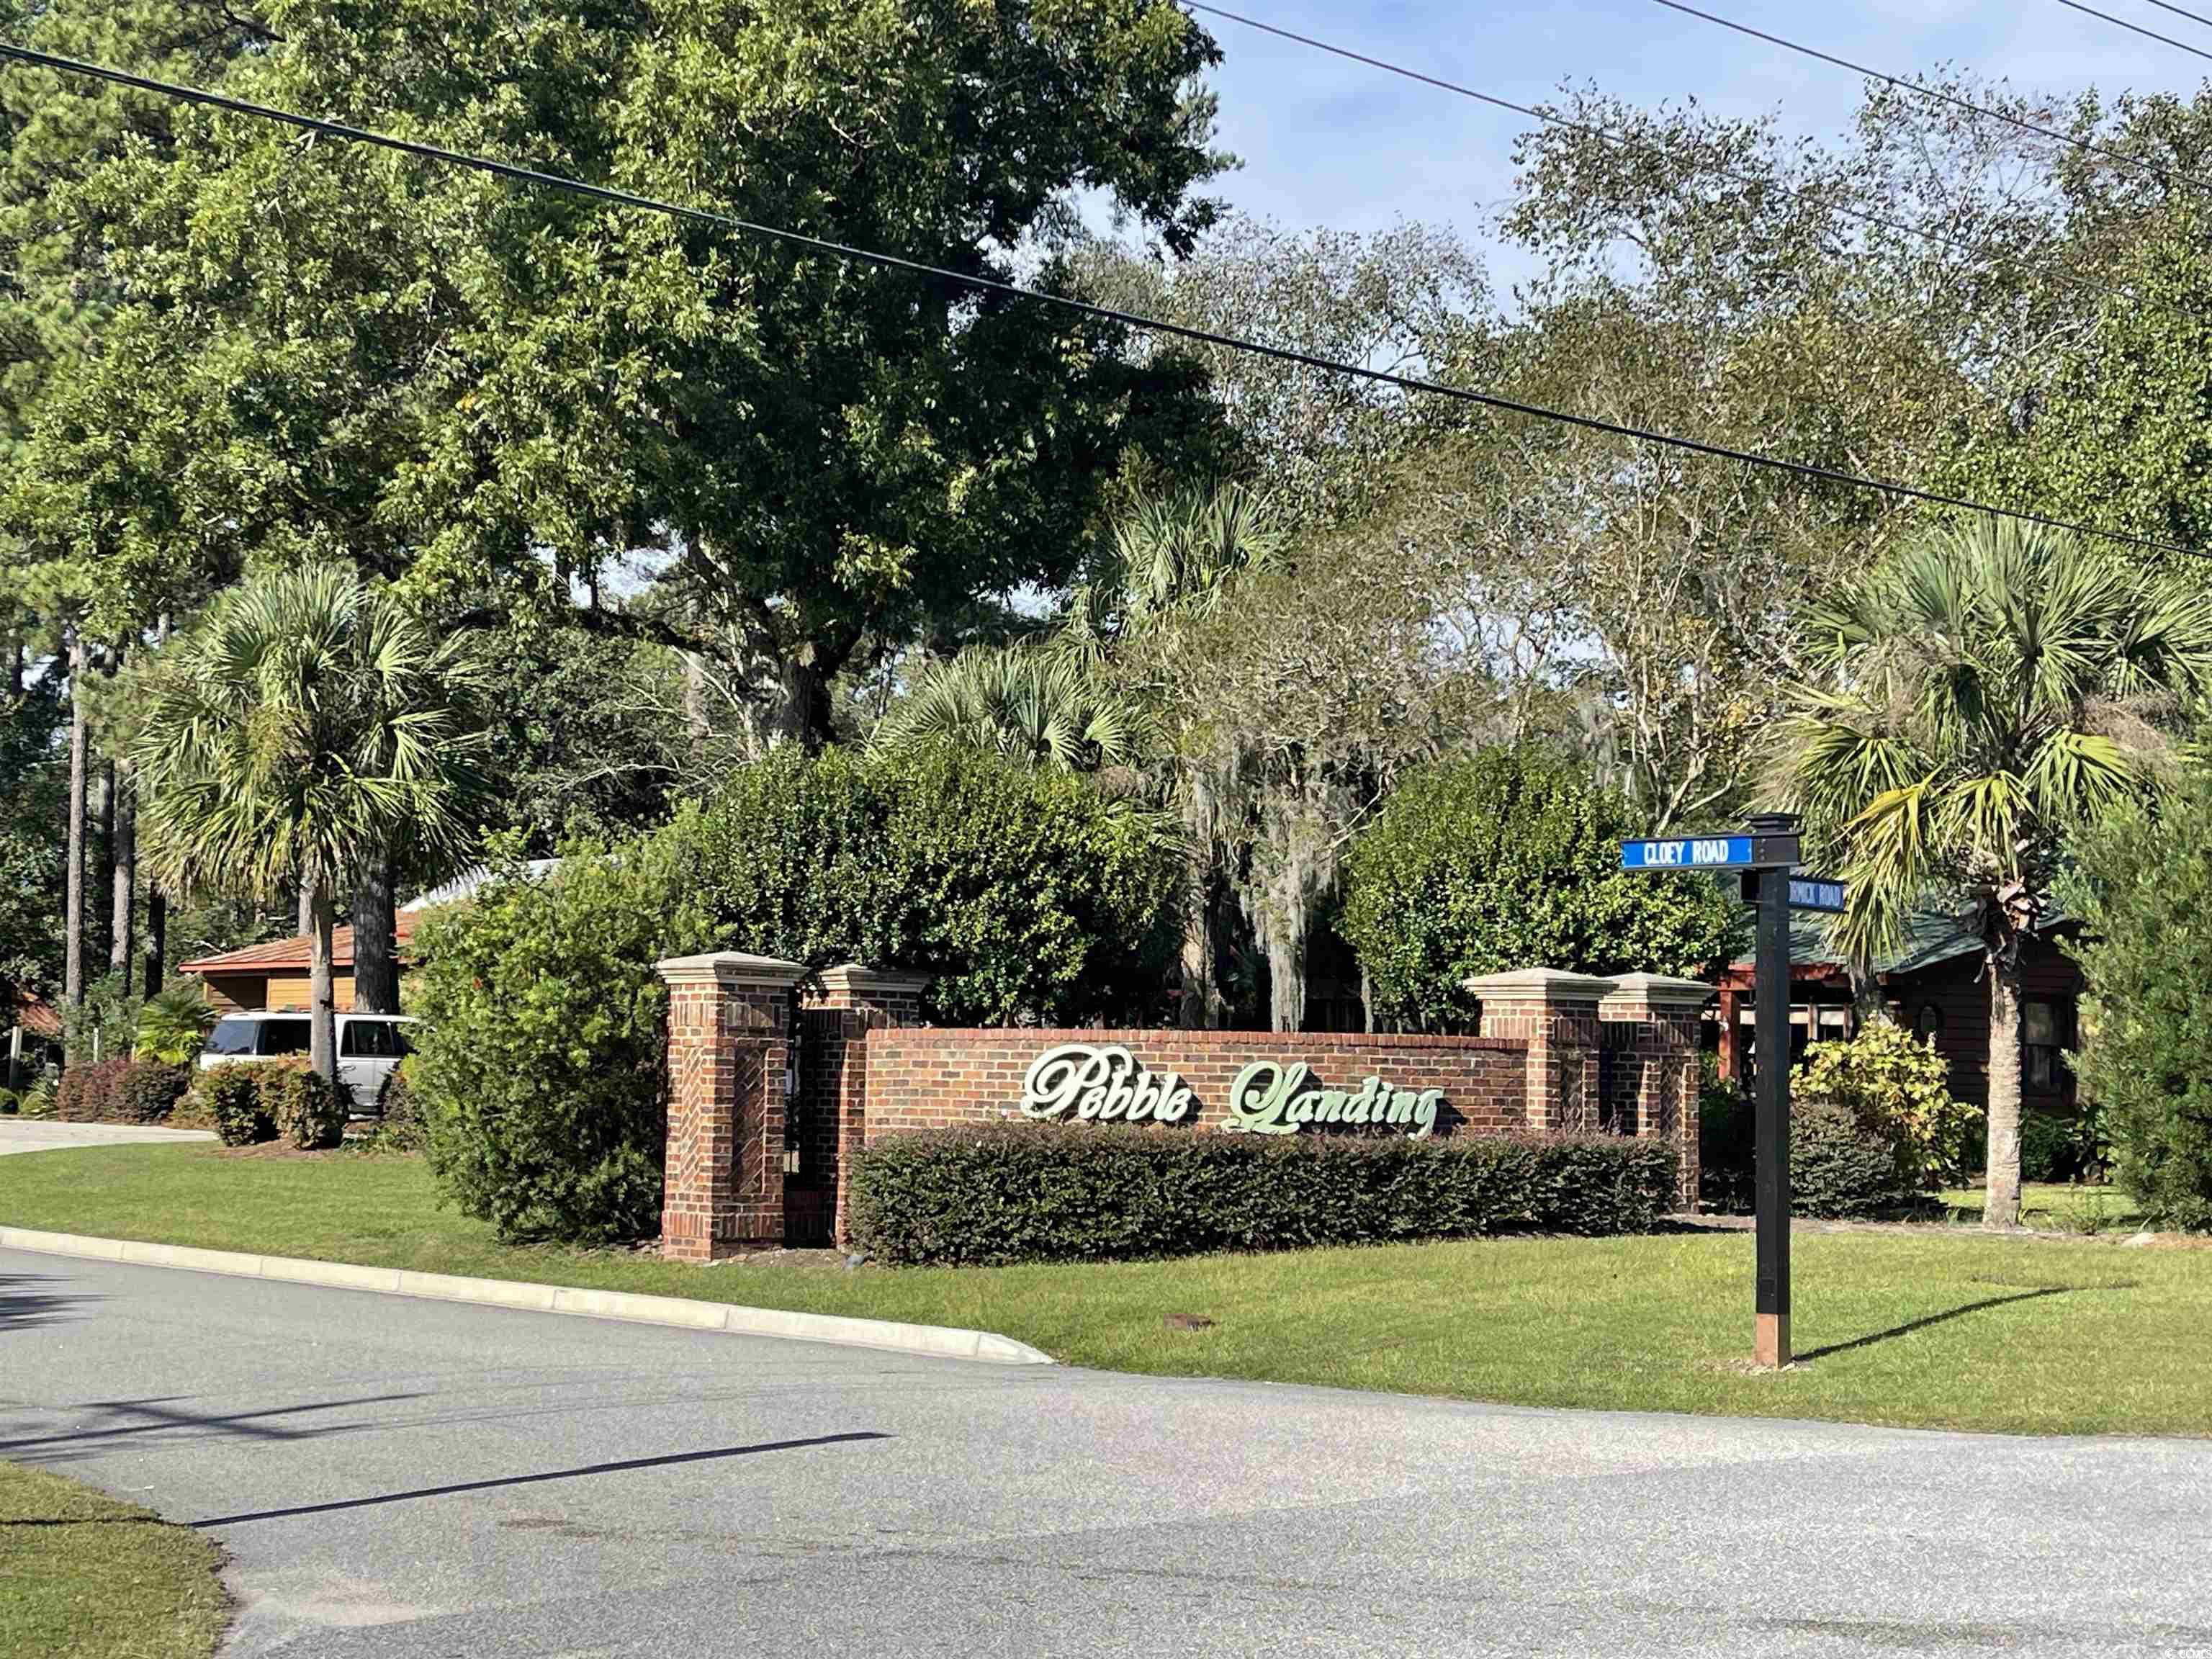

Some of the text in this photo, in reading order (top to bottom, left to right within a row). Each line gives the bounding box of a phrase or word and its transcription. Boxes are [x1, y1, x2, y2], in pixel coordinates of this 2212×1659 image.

[1644, 840, 1729, 864] CLOEY ROAD
[1819, 883, 1841, 907] ROAD
[1020, 1044, 1444, 1140] Pebble Landing
